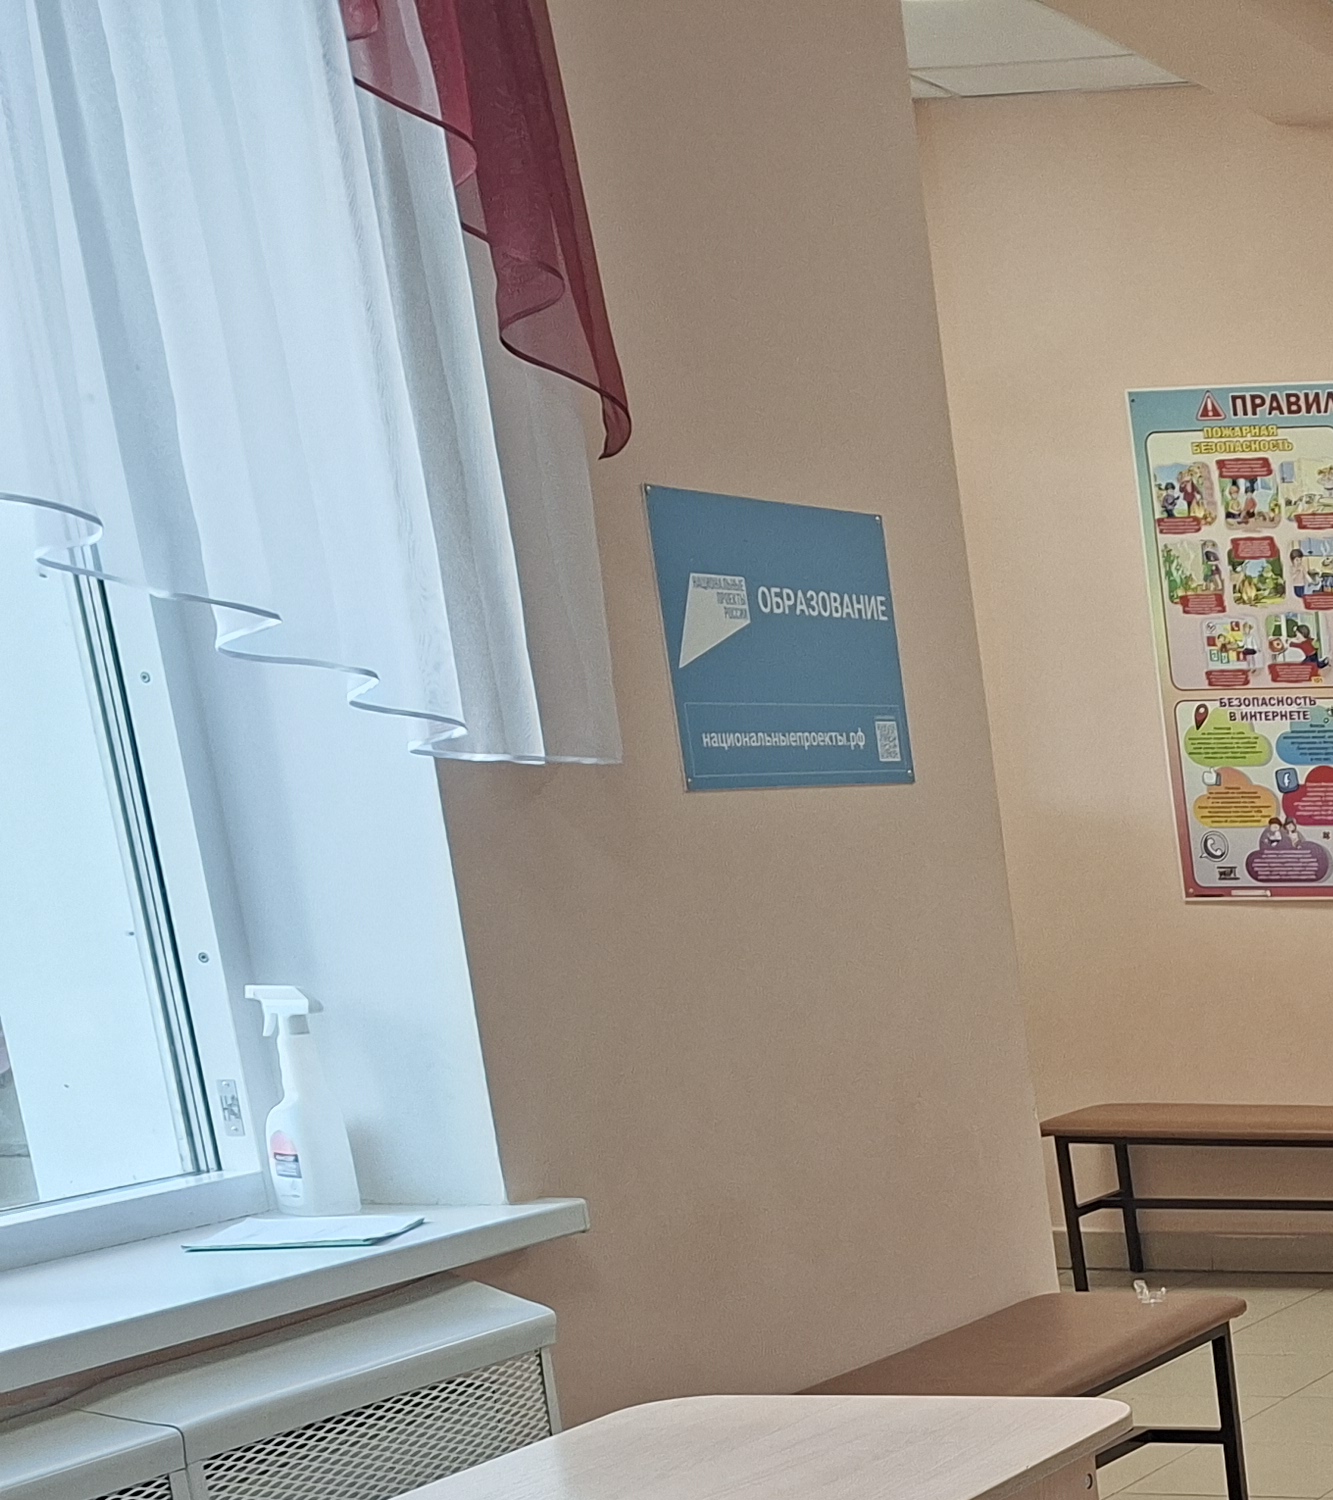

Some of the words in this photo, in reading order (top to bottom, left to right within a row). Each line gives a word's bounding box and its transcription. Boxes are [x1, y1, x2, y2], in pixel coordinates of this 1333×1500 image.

[1203, 425, 1278, 439] ПОЖАРНАЯ
[1191, 439, 1294, 455] БЕЗОПАСНОСТЬ
[757, 585, 888, 622] ОБРАЗОВАНИЕ
[1219, 696, 1316, 708] БЕЗОПАСНОСТЬ
[1229, 712, 1237, 722] В
[1240, 710, 1310, 722] ИНТЕРНЕТЕ
[702, 727, 866, 750] национальныепроекты.рф
